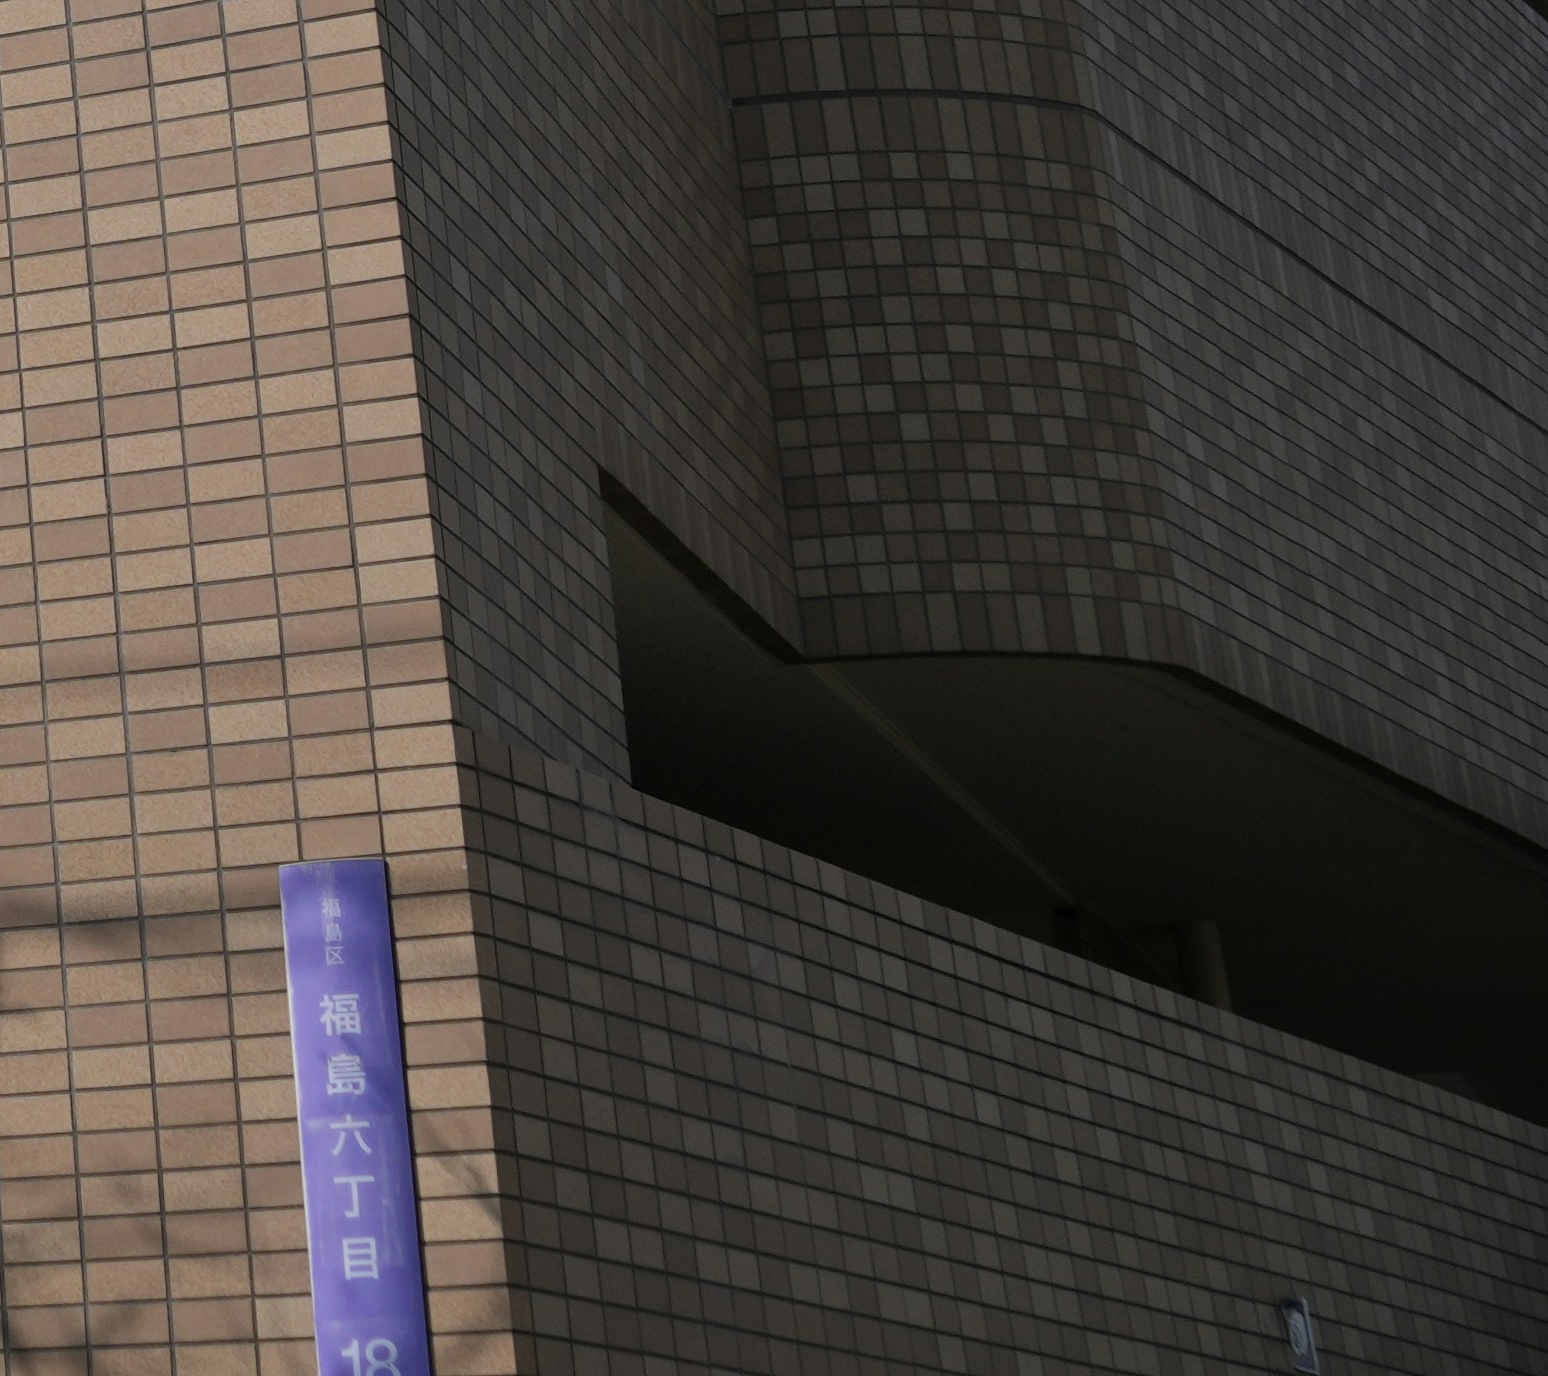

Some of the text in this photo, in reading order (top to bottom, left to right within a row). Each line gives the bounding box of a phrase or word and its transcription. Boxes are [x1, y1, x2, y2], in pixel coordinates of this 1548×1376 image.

[320, 897, 345, 966] 福島区
[319, 992, 380, 1281] 福島六丁目
[340, 1337, 402, 1376] 18
